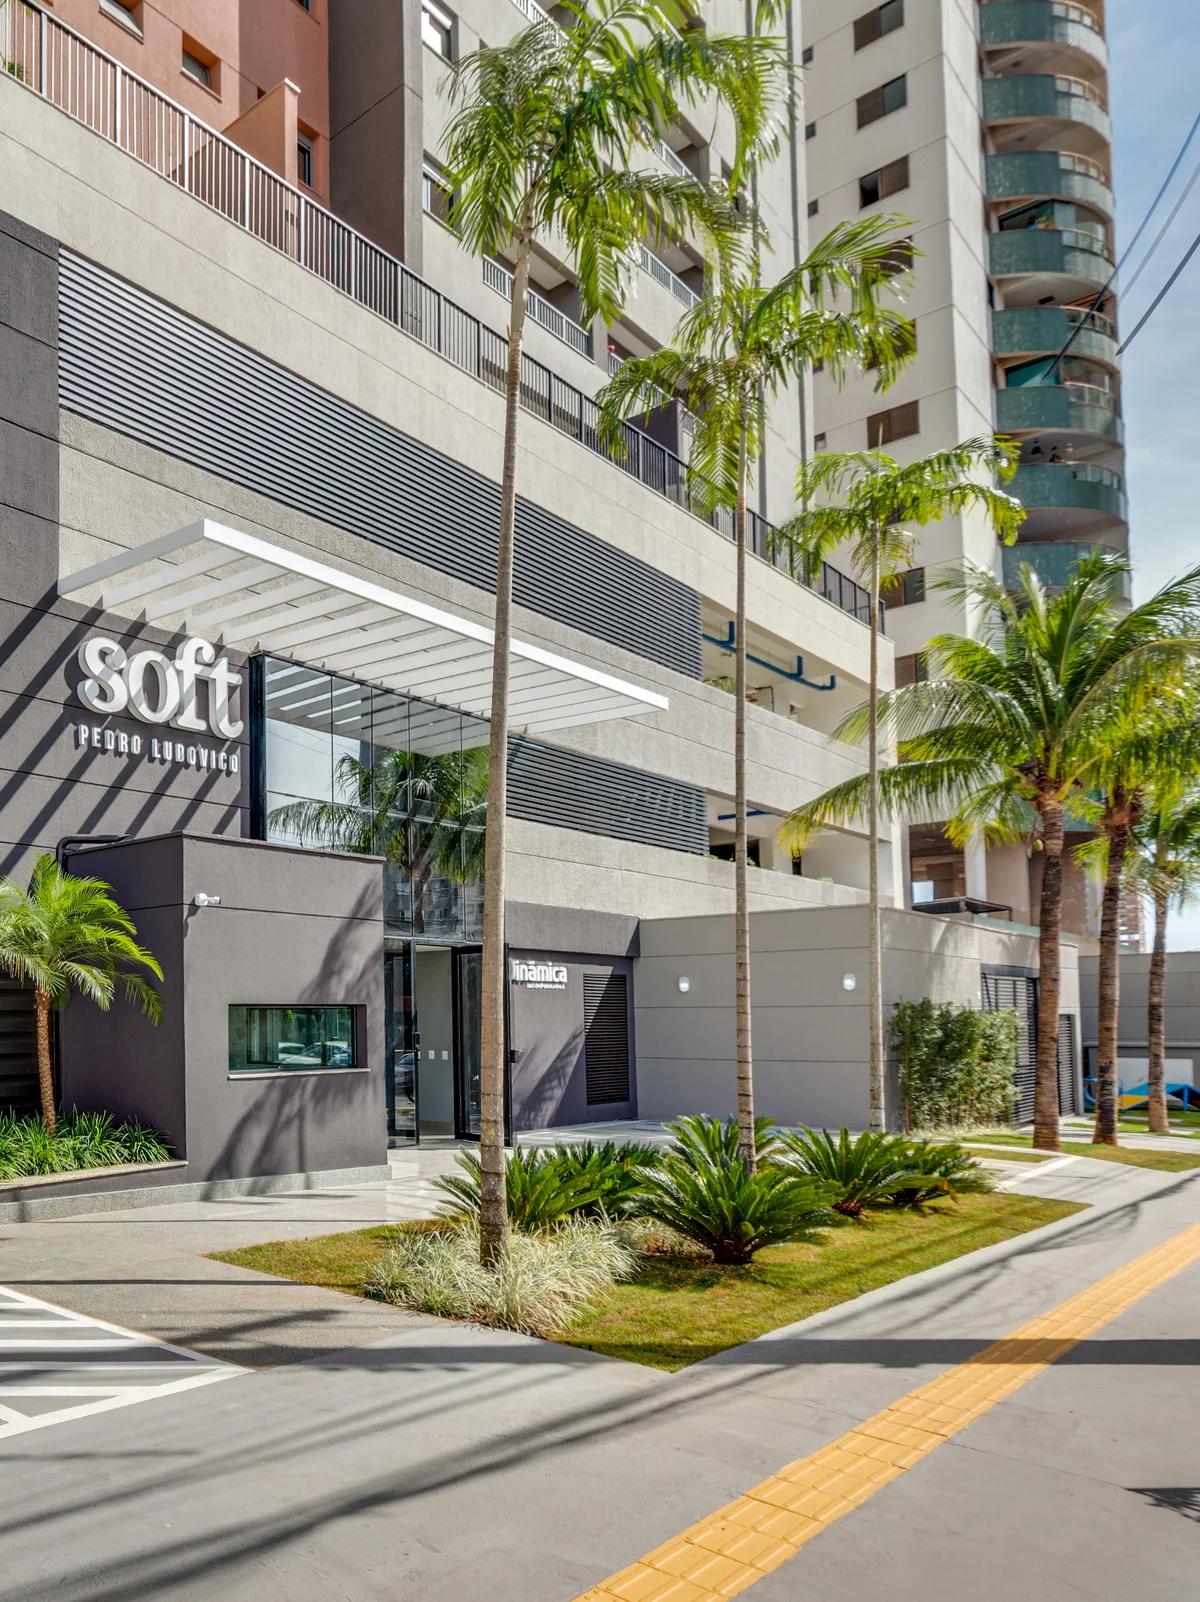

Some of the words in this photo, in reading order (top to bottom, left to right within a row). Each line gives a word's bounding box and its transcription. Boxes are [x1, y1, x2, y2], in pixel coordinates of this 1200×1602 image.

[77, 637, 244, 739] soft
[78, 725, 141, 754] PEDRO
[152, 739, 238, 773] LUDOVICO
